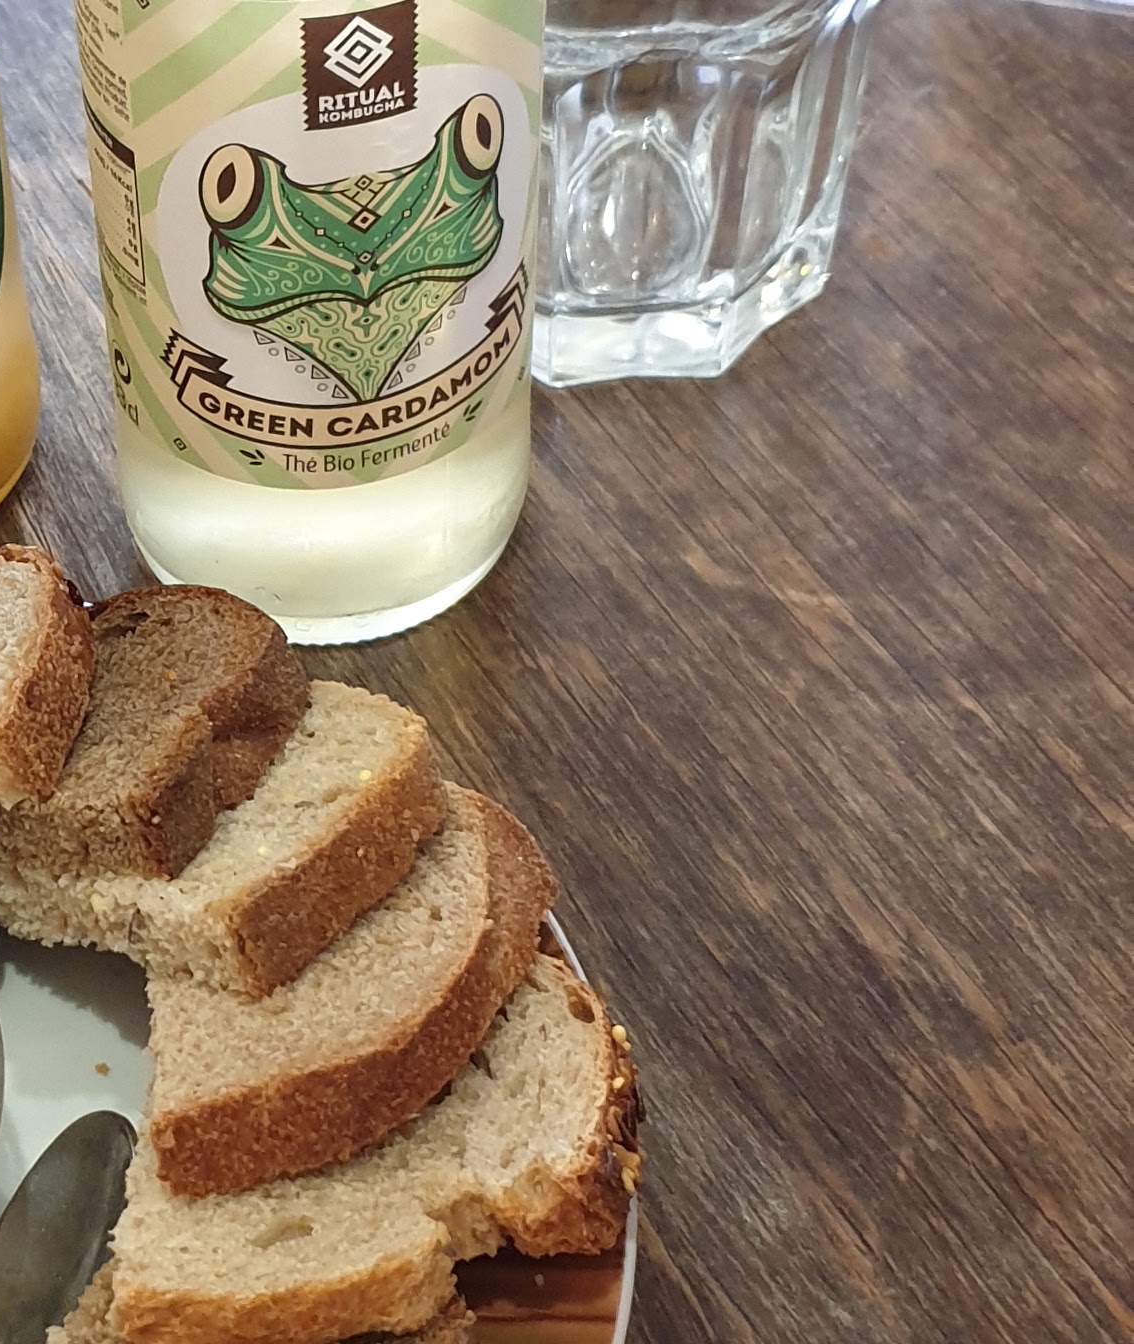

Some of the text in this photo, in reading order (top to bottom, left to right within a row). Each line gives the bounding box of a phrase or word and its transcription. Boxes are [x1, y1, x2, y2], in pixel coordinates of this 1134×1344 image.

[318, 80, 405, 112] RITUAL
[319, 98, 405, 123] KOMBUCHA
[198, 327, 511, 438] GREEN CARDAMOM
[283, 421, 450, 473] Thé Bio Fermenté
